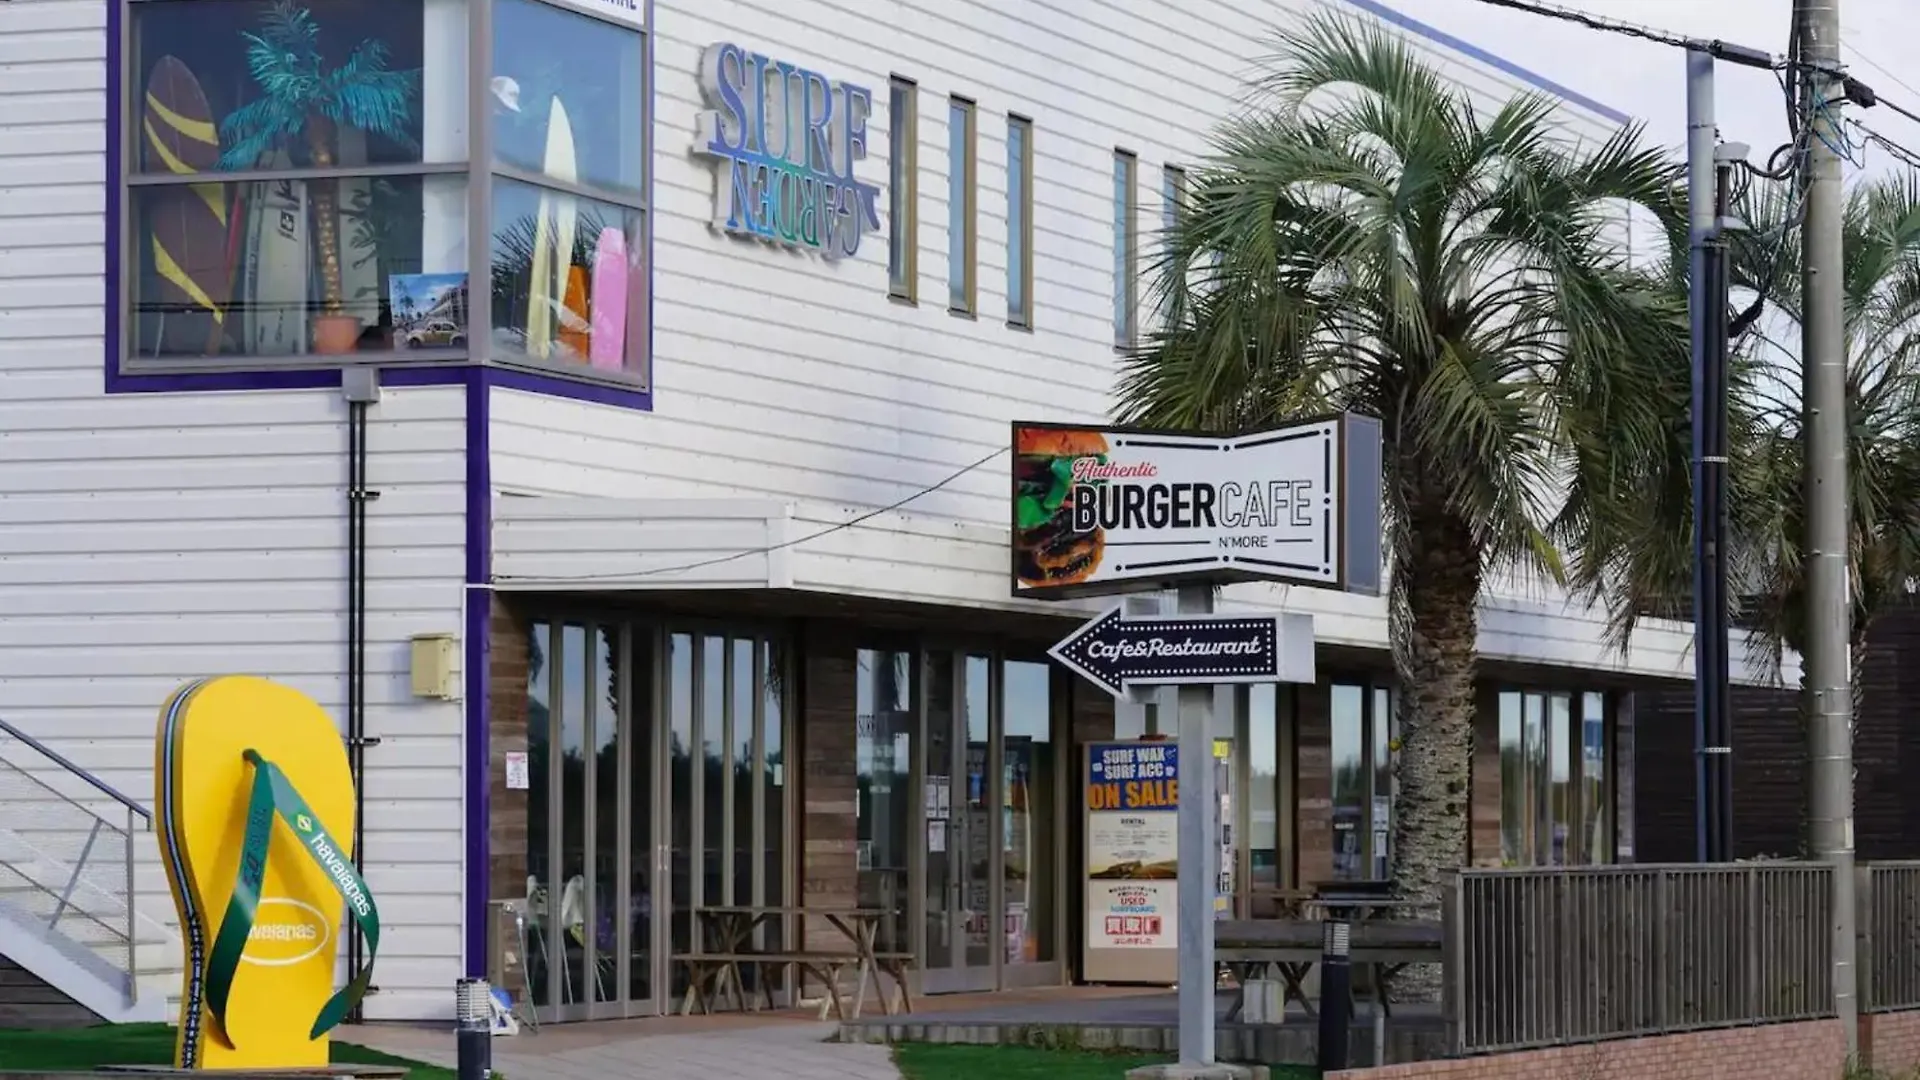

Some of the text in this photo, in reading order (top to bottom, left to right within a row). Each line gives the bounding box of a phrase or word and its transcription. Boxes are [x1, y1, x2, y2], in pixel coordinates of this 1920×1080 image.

[706, 42, 872, 179] SURF
[725, 157, 872, 257] GARDEN
[1073, 460, 1158, 480] Authentic
[1074, 480, 1312, 532] BURGER CAFE
[1219, 536, 1269, 548] N'MORE
[1088, 636, 1262, 663] Cafe&Restaurant
[1103, 747, 1165, 764] SURF WAX
[1104, 762, 1164, 779] SURF ACC
[1088, 779, 1179, 808] ON SALE
[311, 833, 371, 916] havaianas
[248, 923, 317, 942] vaianas
